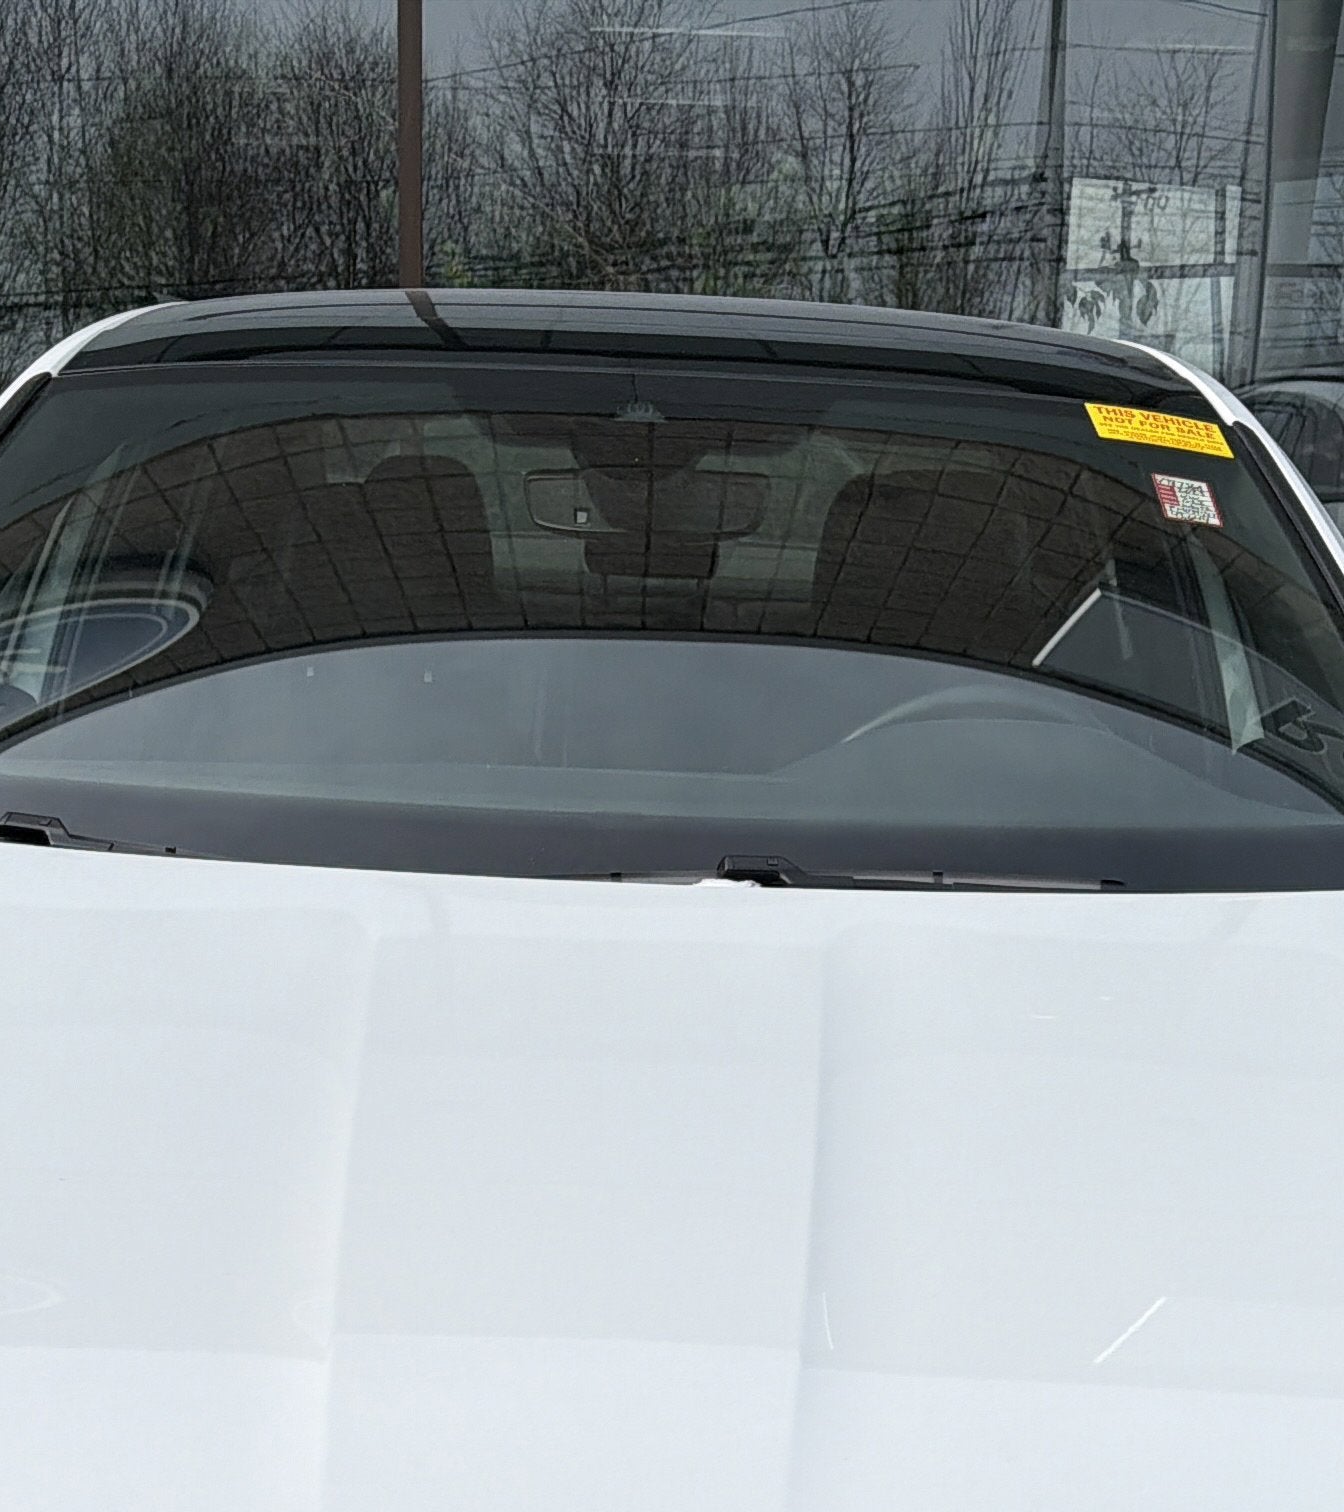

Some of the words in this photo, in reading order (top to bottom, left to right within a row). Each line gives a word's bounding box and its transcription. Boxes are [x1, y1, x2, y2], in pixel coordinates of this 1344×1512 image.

[1095, 406, 1136, 419] THIS
[1140, 411, 1218, 434] VEHICLE
[1103, 415, 1130, 426] NOT
[1139, 420, 1171, 433] FOR
[1176, 426, 1218, 440] SALE
